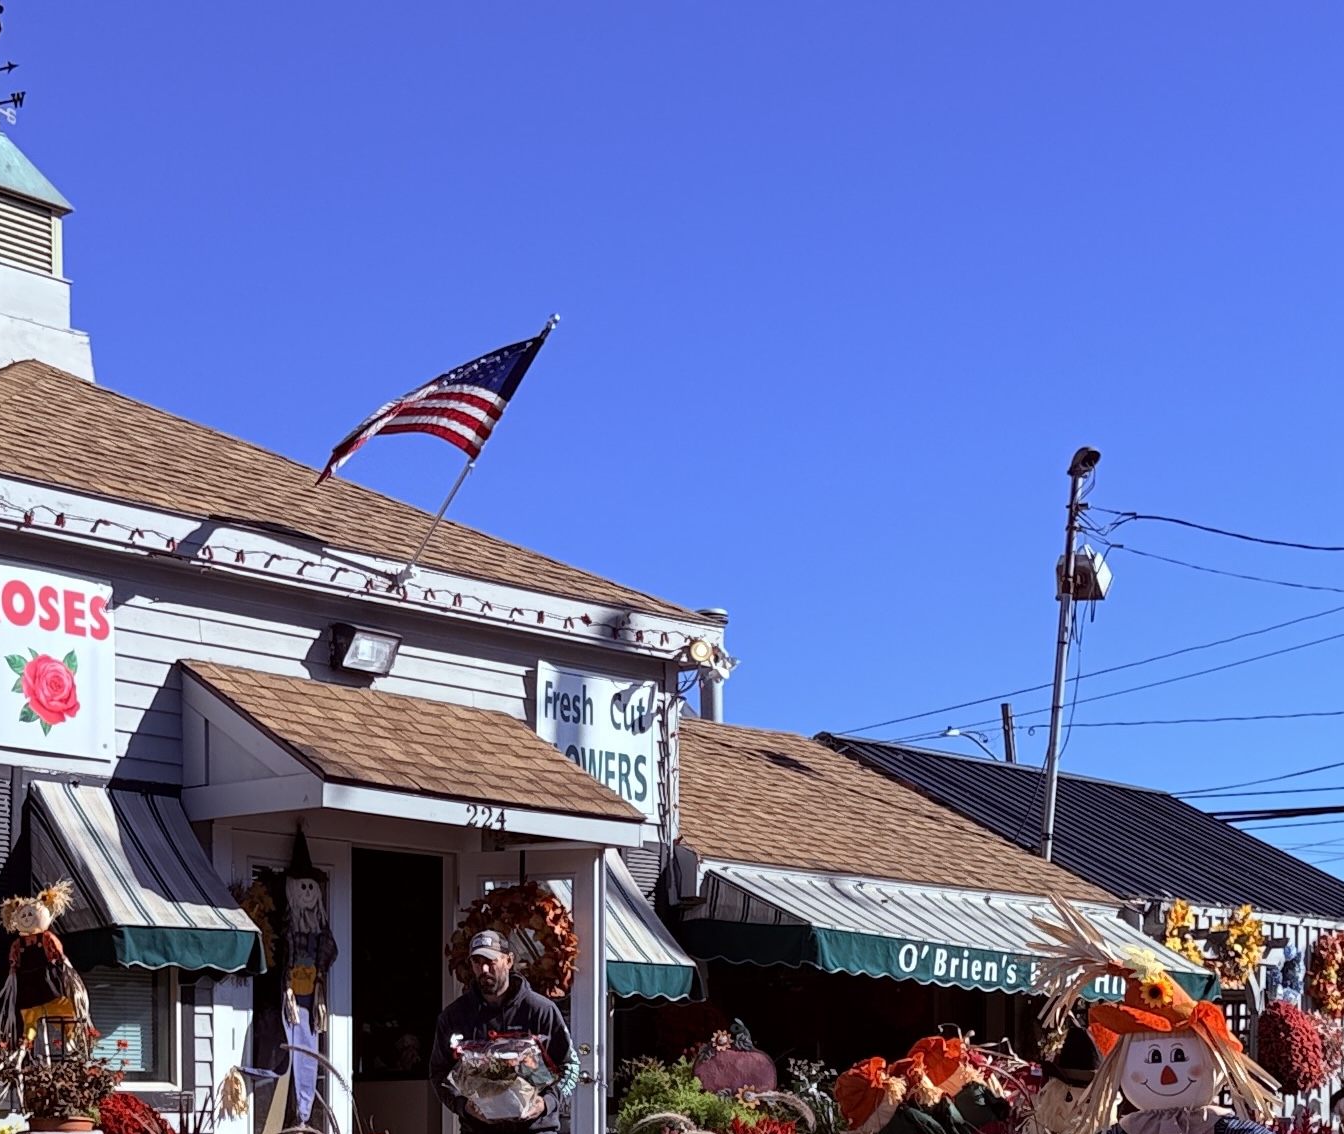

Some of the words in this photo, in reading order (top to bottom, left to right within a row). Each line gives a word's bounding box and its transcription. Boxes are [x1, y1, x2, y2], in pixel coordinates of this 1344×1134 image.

[544, 680, 593, 726] Fresh
[610, 692, 645, 734] Cut
[553, 743, 647, 801] WERS
[466, 803, 506, 831] 224
[898, 943, 1018, 983] O'Brien's
